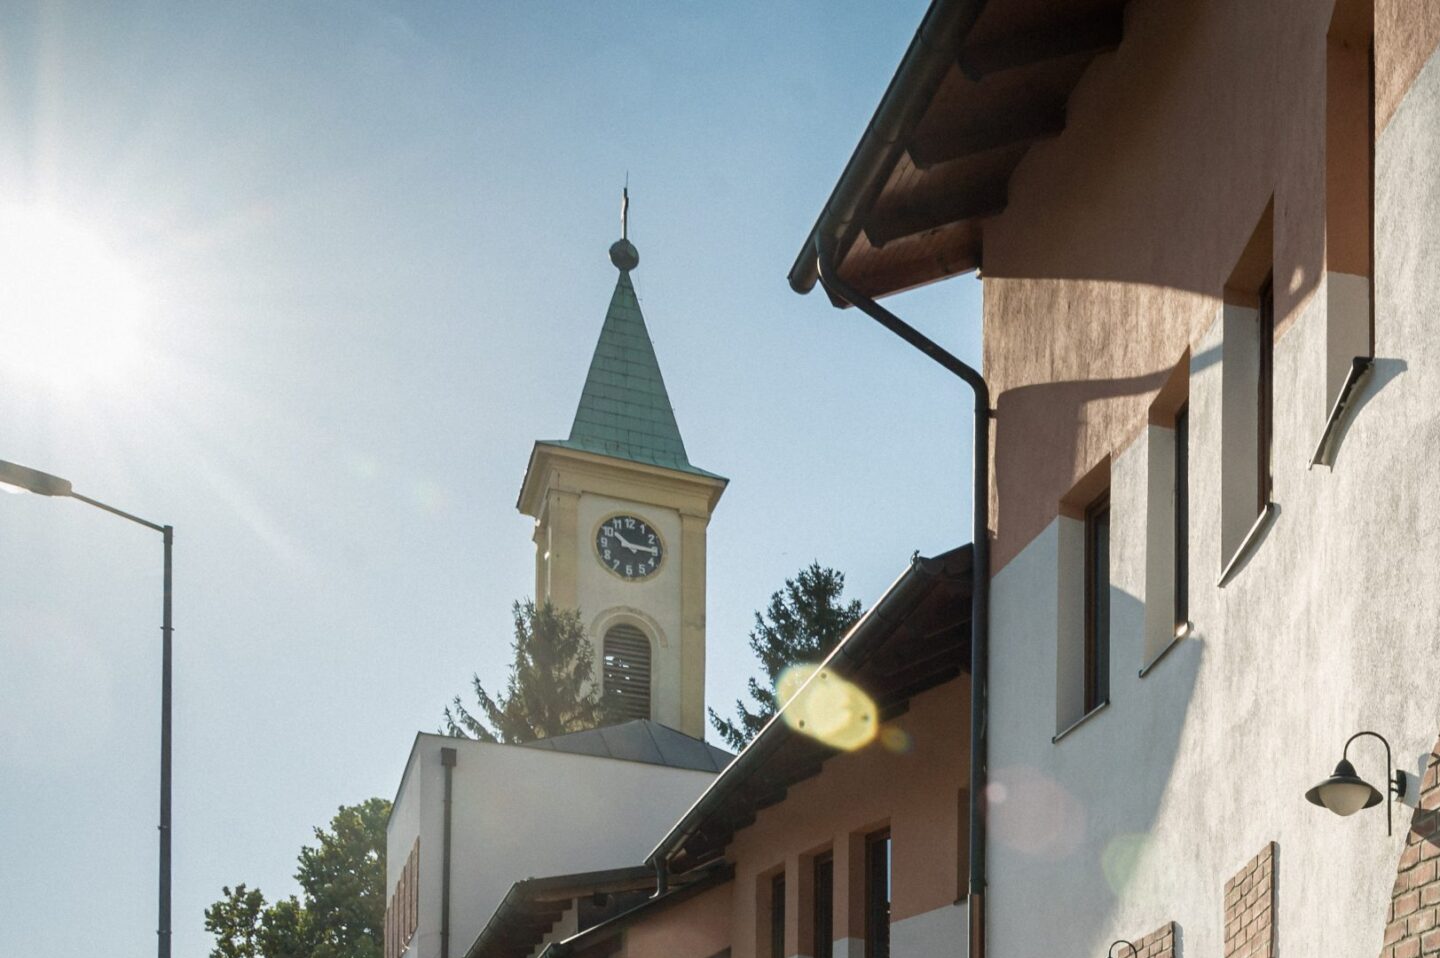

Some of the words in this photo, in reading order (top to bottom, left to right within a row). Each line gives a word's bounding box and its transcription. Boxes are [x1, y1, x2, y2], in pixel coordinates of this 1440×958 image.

[625, 518, 635, 530] 12
[603, 526, 614, 537] 10
[601, 537, 608, 547] 9
[648, 534, 654, 544] 2
[604, 549, 611, 560] 8
[626, 565, 633, 575] 6
